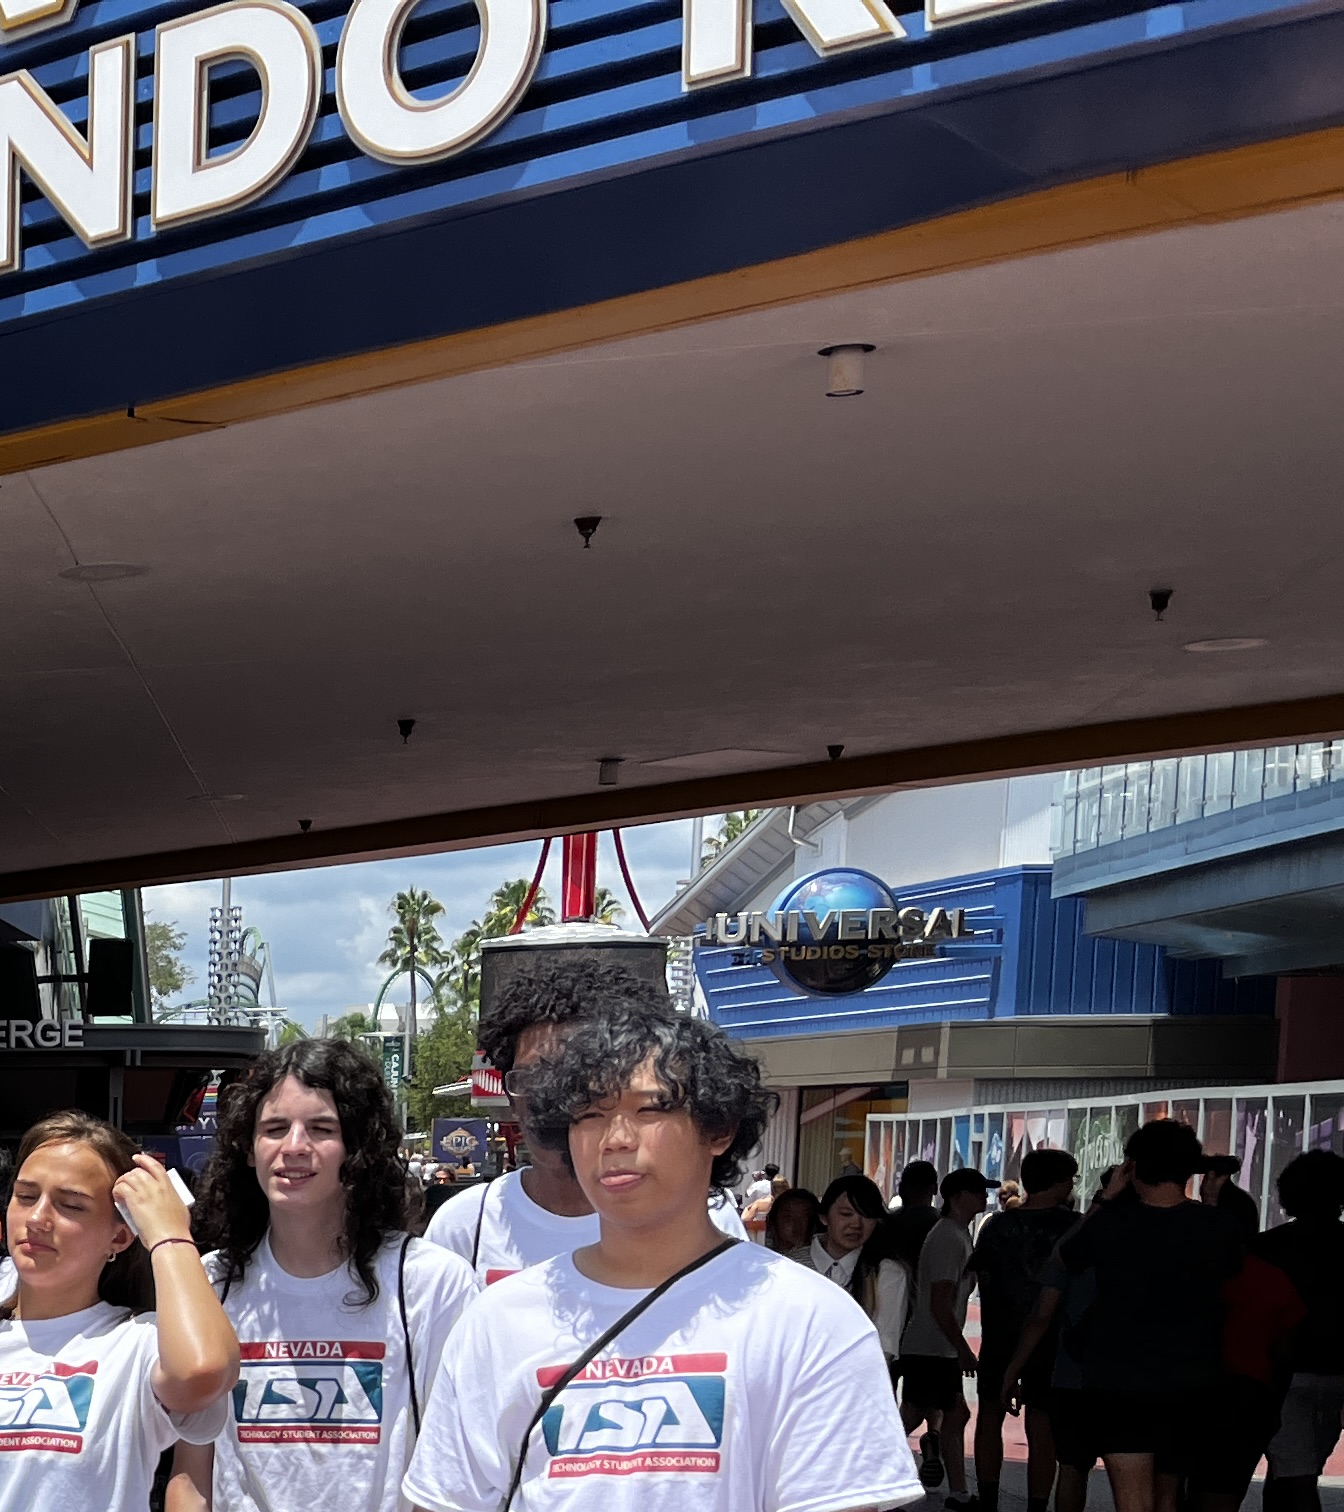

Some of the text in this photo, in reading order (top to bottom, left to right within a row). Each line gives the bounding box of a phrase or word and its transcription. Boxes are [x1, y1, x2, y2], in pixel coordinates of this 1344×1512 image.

[709, 906, 976, 944] UNIVERSAL
[763, 944, 859, 963] STUDIOS
[263, 1341, 343, 1358] NEVADA
[585, 1356, 675, 1379] NEVADA
[240, 1365, 379, 1420] TSA
[549, 1381, 717, 1451] TSA
[20, 1436, 78, 1449] ASSOCIATION
[282, 1430, 320, 1439] STUDENT
[321, 1430, 378, 1440] ASSOCIATION
[643, 1456, 716, 1467] ASSOCIATION
